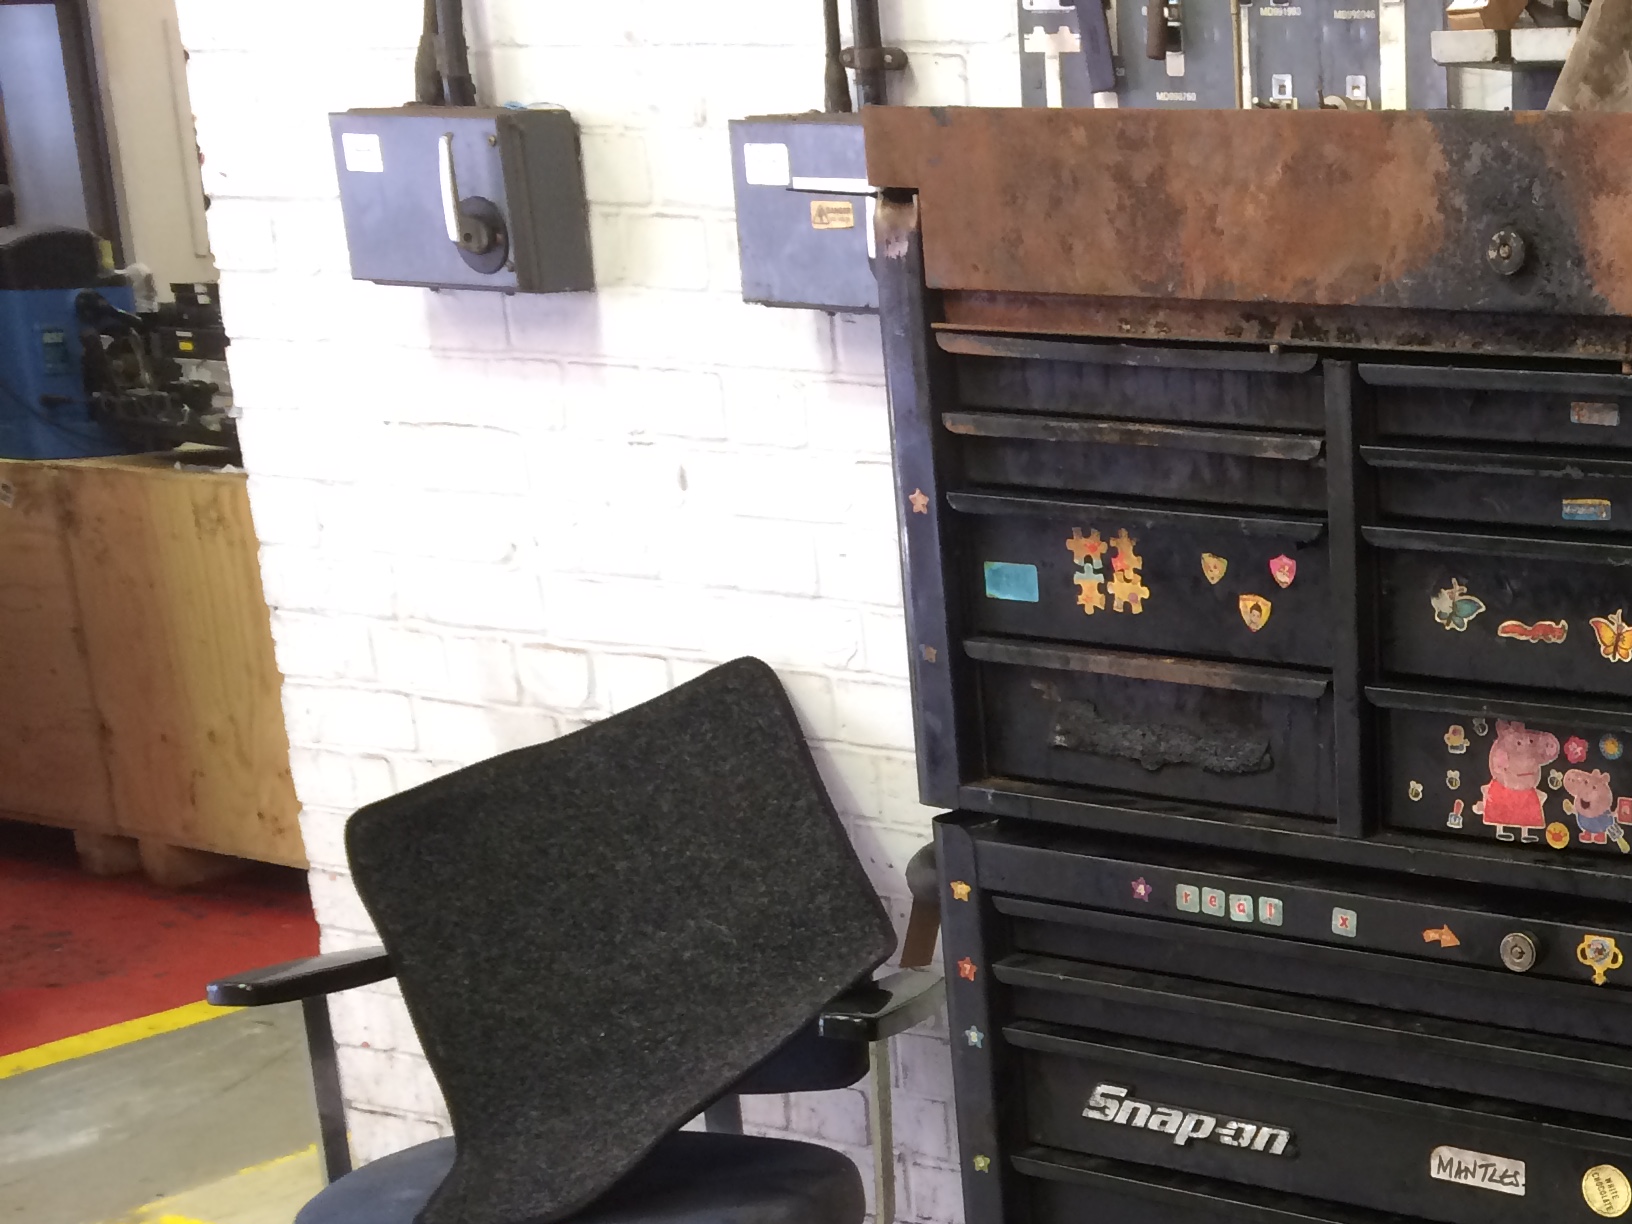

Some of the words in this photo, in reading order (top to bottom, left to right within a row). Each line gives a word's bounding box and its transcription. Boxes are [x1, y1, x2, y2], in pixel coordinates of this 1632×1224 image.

[1081, 1084, 1291, 1156] Snap-on
[1591, 1171, 1615, 1212] CHOCOLATE
[1605, 1177, 1620, 1201] WHITE
